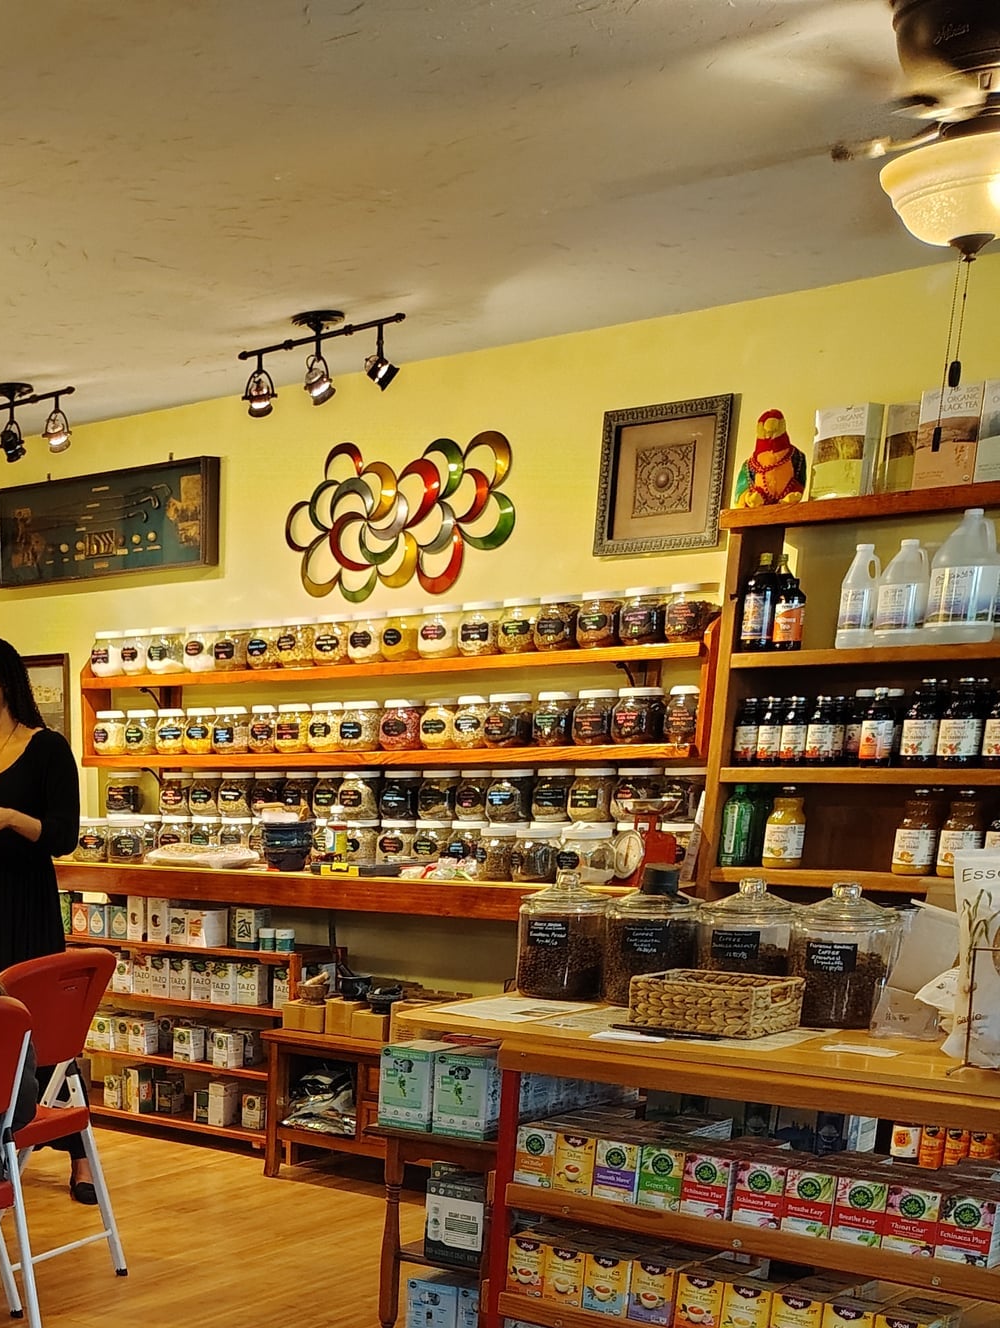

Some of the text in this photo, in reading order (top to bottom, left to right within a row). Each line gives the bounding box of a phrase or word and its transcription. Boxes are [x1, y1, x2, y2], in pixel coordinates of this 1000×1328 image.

[965, 400, 979, 409] TEA
[134, 970, 149, 979] TAZO
[152, 975, 167, 983] TAZO
[170, 977, 186, 985] TAZO
[192, 977, 211, 985] TAZO
[212, 982, 230, 990] TAZO
[645, 1181, 675, 1193] Green Tea
[838, 1212, 878, 1226] Breathe Easy
[940, 1230, 989, 1245] Echinacea Plus
[787, 1297, 805, 1308] yogi
[839, 1309, 856, 1319] yogi
